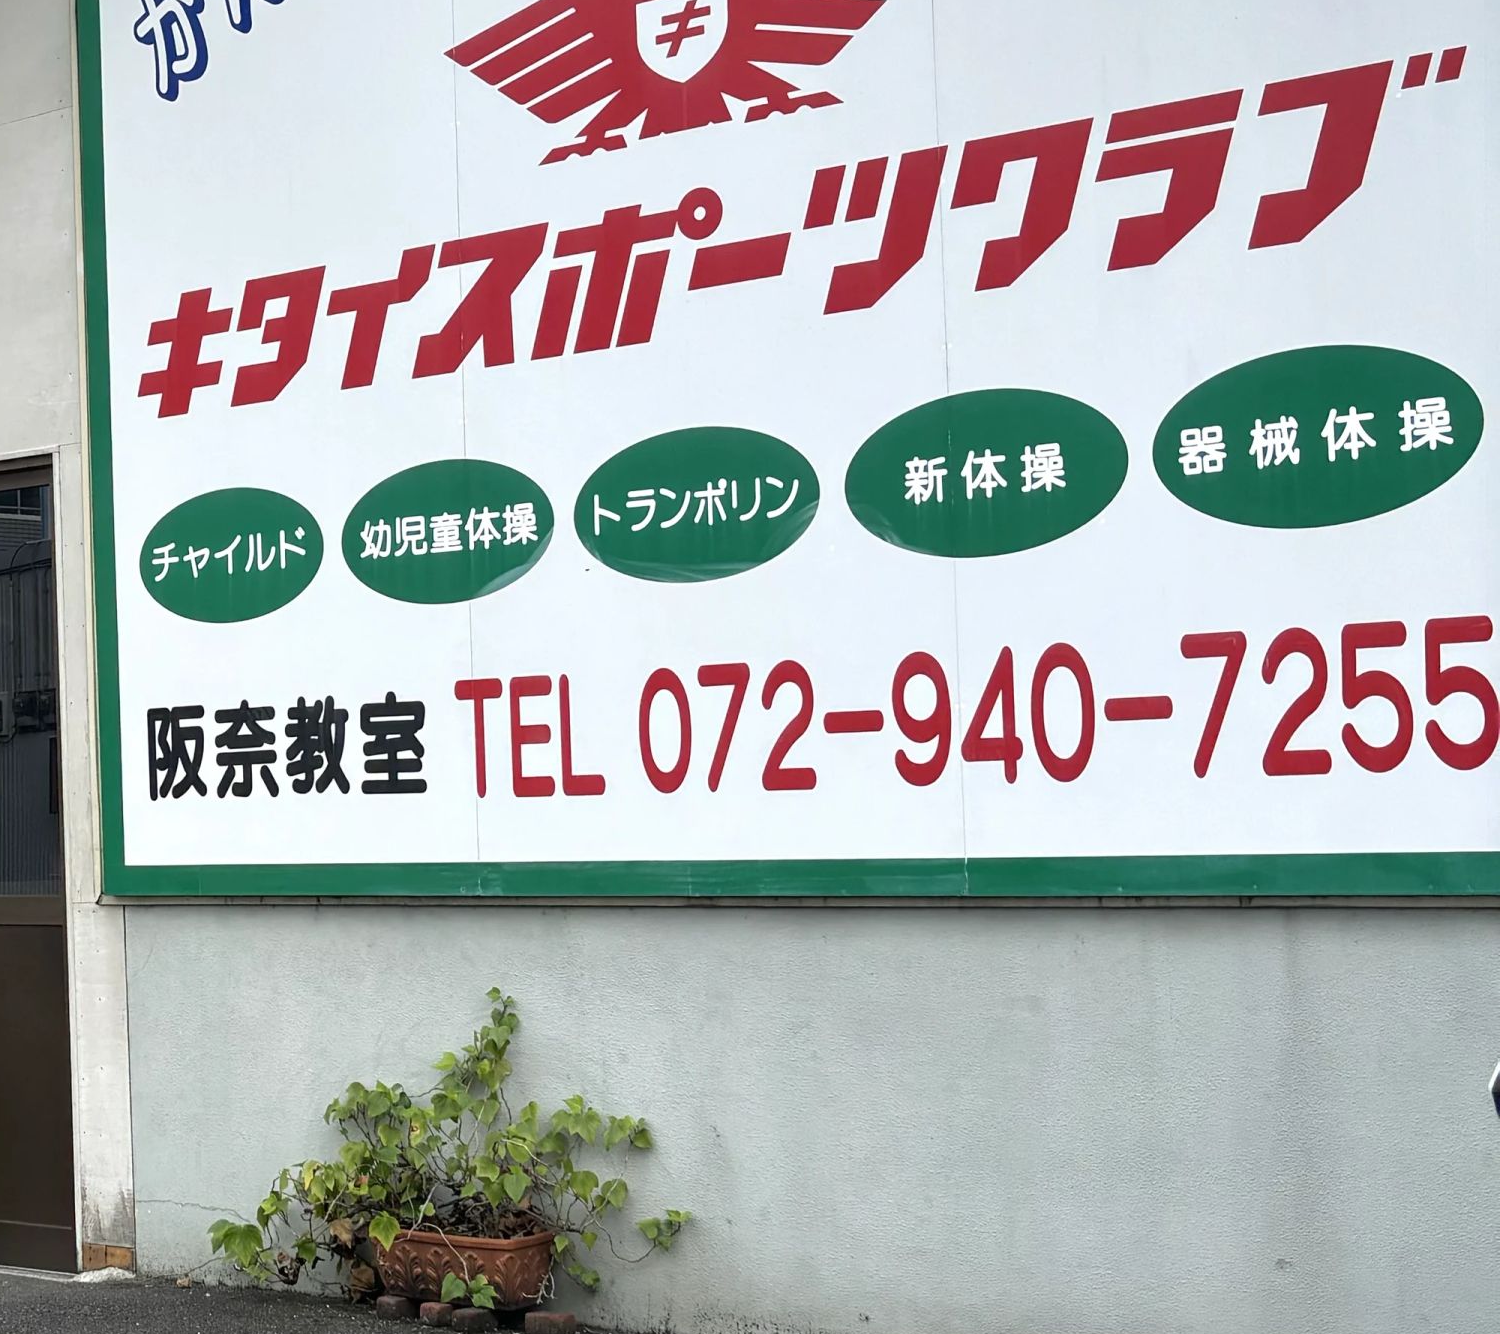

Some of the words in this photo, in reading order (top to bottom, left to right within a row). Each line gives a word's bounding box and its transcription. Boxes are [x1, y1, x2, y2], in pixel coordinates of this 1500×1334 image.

[137, 46, 1466, 417] キタイスポーツクラブ
[1177, 395, 1454, 476] 器械体操
[903, 442, 1067, 505] 新体操
[359, 502, 539, 558] 幼児童体操
[591, 476, 801, 537] トランポリン
[151, 526, 306, 583] チャイルド
[146, 691, 428, 802] 阪奈教室
[455, 674, 607, 799] TEL
[639, 615, 1500, 794] 072-940-7255
